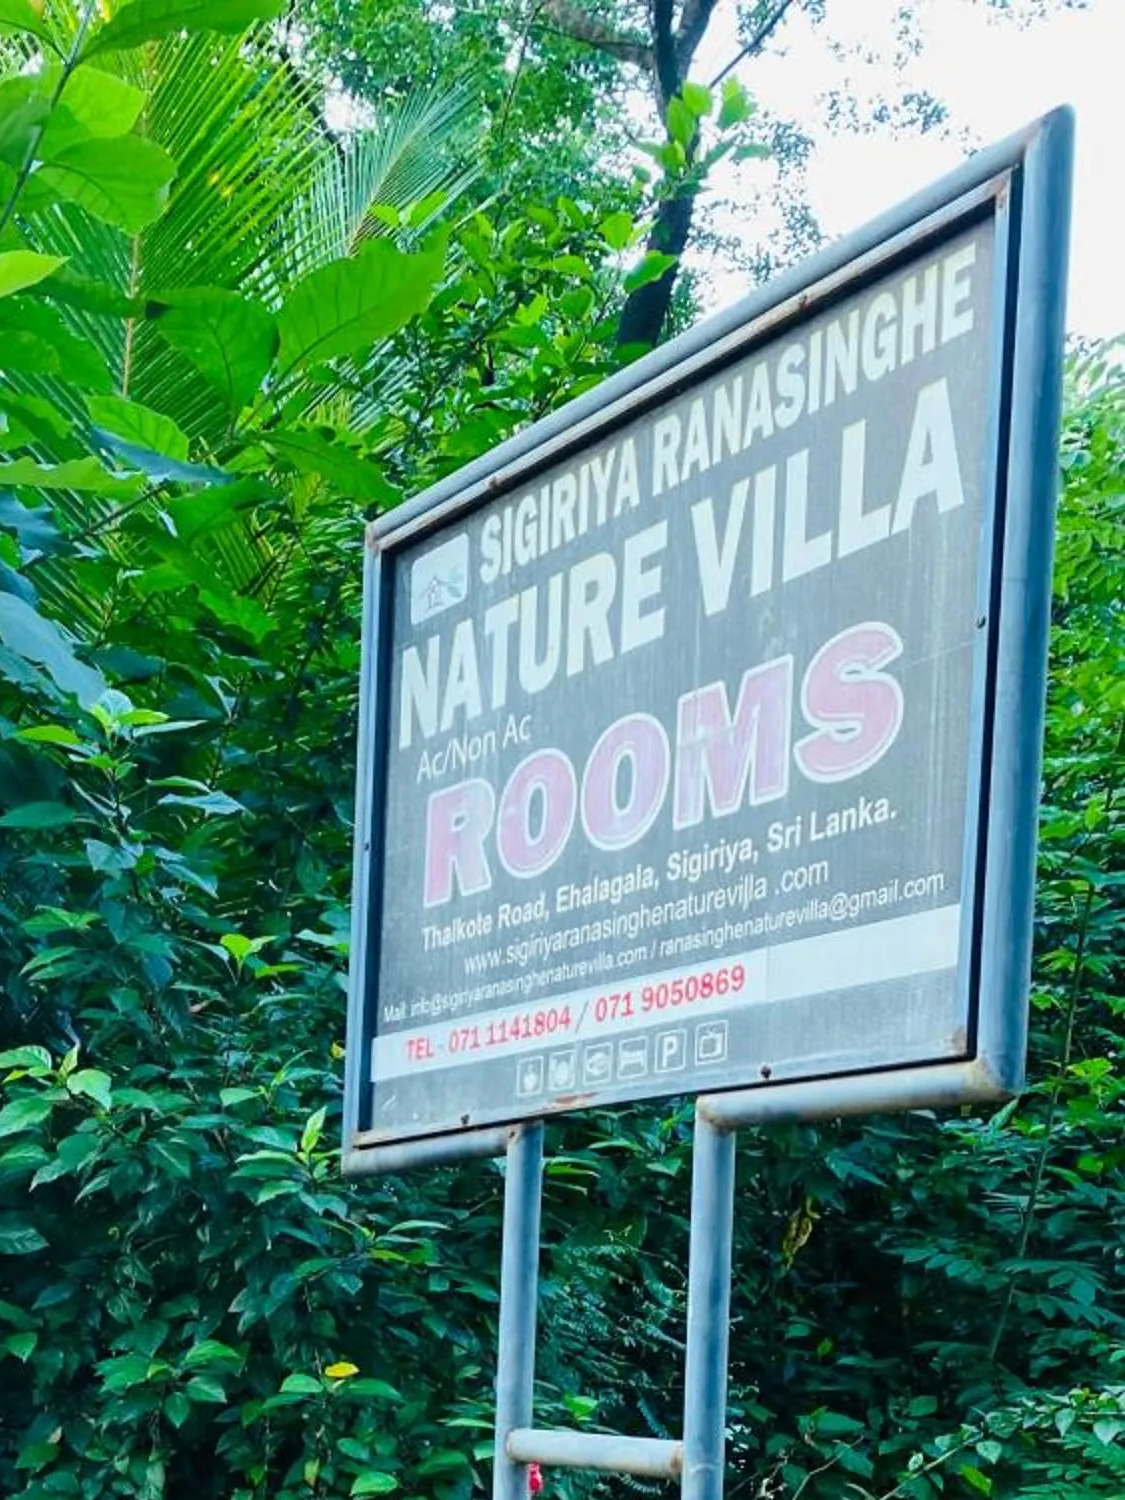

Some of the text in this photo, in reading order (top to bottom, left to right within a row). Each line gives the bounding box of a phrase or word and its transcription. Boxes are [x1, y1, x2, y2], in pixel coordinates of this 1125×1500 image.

[480, 244, 977, 583] SIGIRIYA RANASINGHE
[399, 377, 965, 751] NATURE VILLA
[417, 713, 532, 784] Ac/Non Ac
[423, 621, 905, 908] ROOMS
[422, 795, 897, 952] Thalkote Road, Ehalagala, Sigiriya, Sri Lanka.
[660, 871, 945, 957] ranasinghenaturevilla@gmail.com
[406, 1036, 434, 1061] TEL
[449, 1026, 481, 1054] 071
[486, 1004, 571, 1047] 1141804
[575, 1000, 589, 1033] /
[595, 990, 635, 1022] 071
[641, 963, 746, 1013] 9050869
